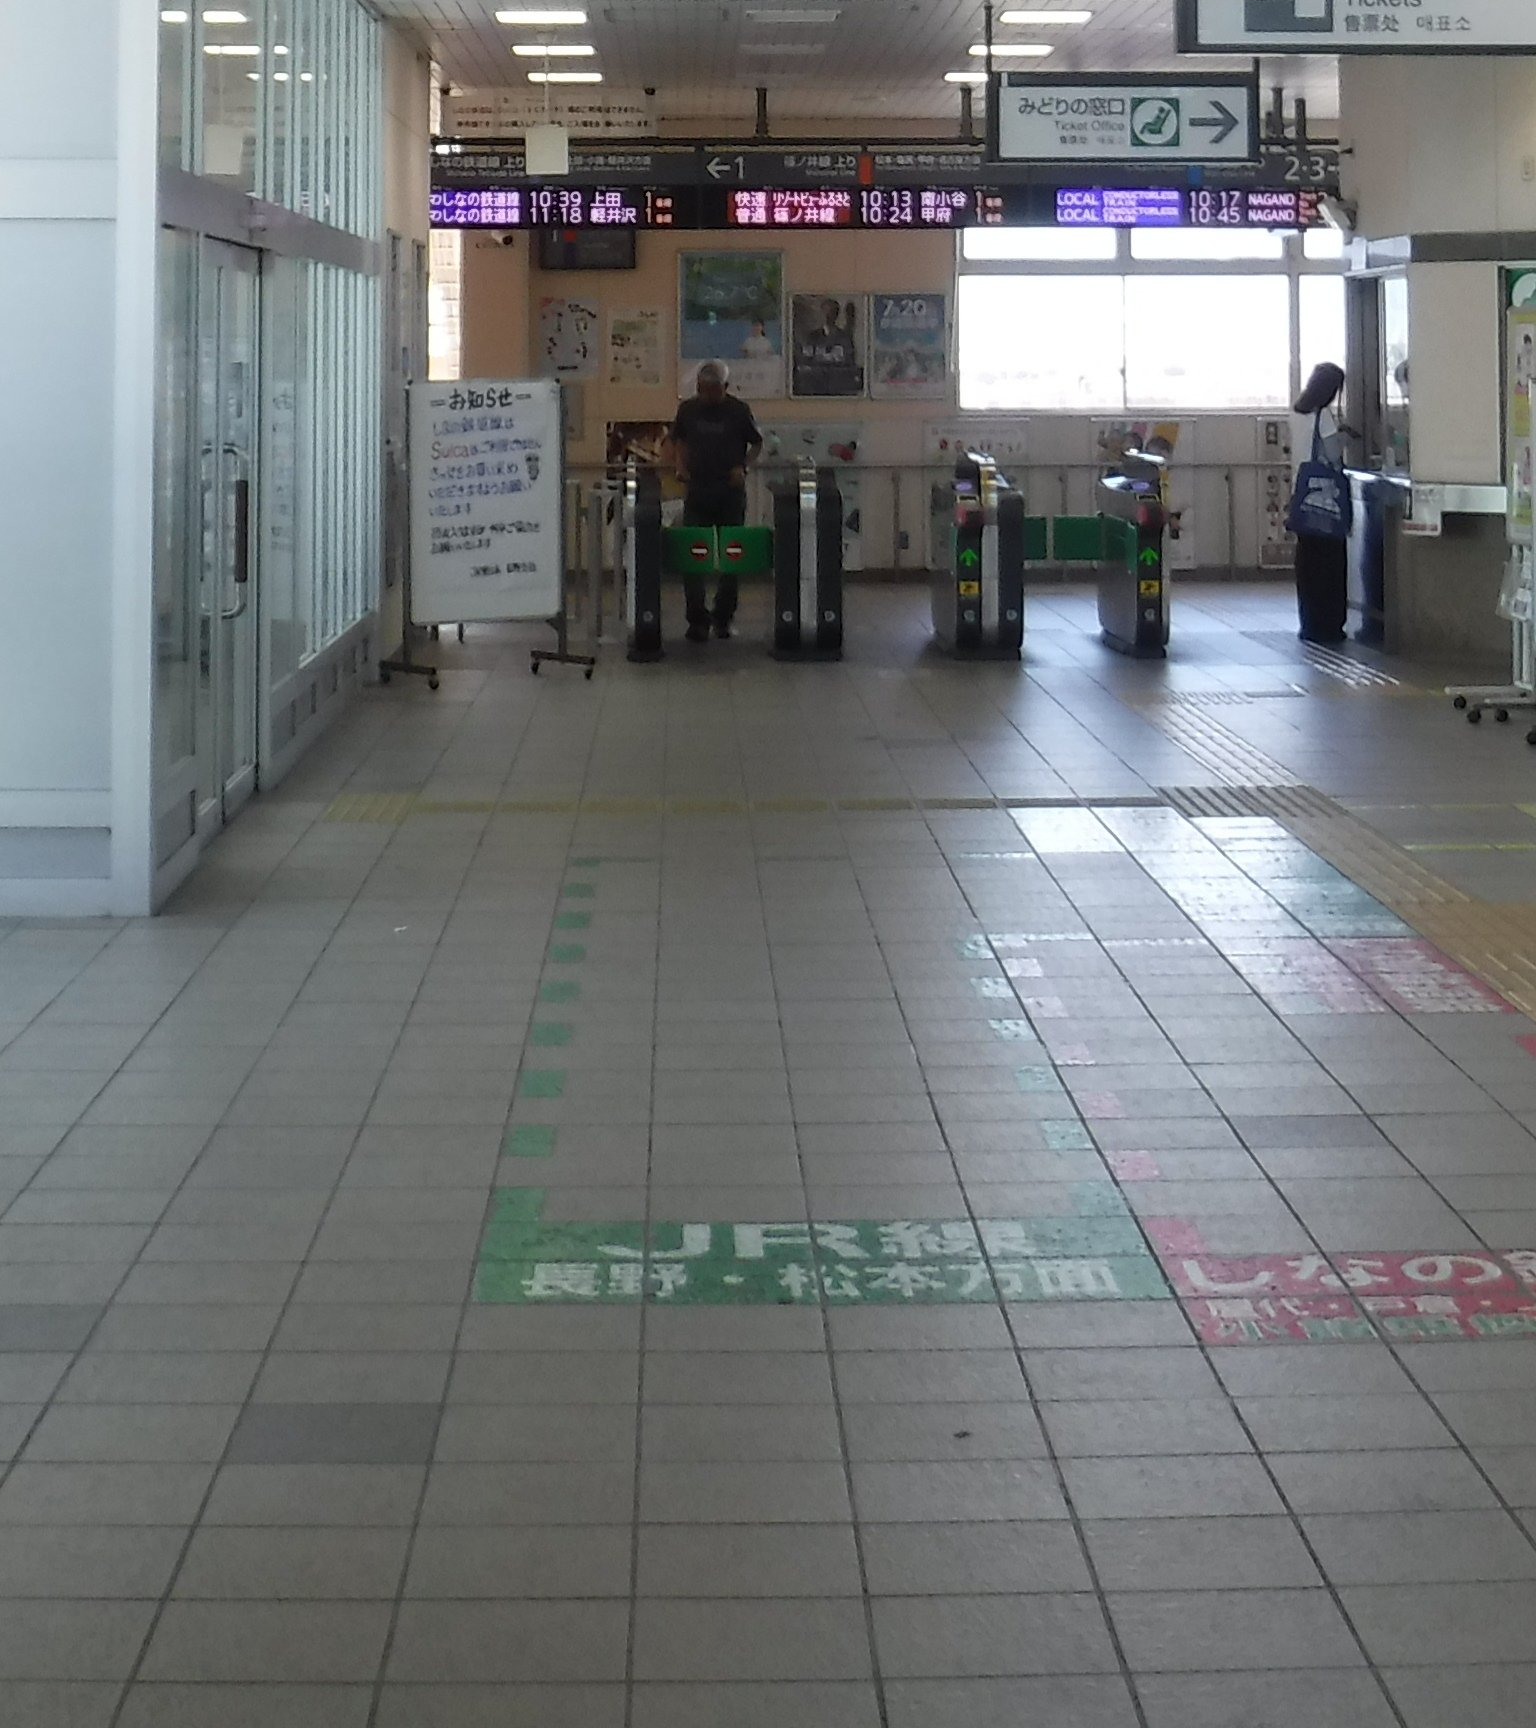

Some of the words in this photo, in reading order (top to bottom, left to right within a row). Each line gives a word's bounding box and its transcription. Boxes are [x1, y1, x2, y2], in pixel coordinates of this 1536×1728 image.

[1018, 97, 1126, 116] みどりの窓口
[530, 191, 582, 207] 10:39
[590, 191, 622, 207] 上田
[735, 191, 766, 207] 快速
[861, 191, 913, 207] 10:13
[920, 191, 967, 208] 南小谷
[1056, 191, 1099, 206] LOCAL
[1189, 191, 1241, 207] 10:17
[1248, 192, 1296, 206] NAGANO
[530, 208, 582, 223] 11:18
[590, 208, 638, 223] 軽井沢
[735, 208, 766, 223] 普通
[861, 208, 913, 223] 10:24
[920, 208, 952, 223] 甲府
[1056, 208, 1099, 223] LOCAL
[1189, 207, 1241, 223] 10:45
[1248, 208, 1296, 223] NAGANO
[598, 1220, 1039, 1259] JR線
[522, 1259, 1122, 1299] 長野・松本方面
